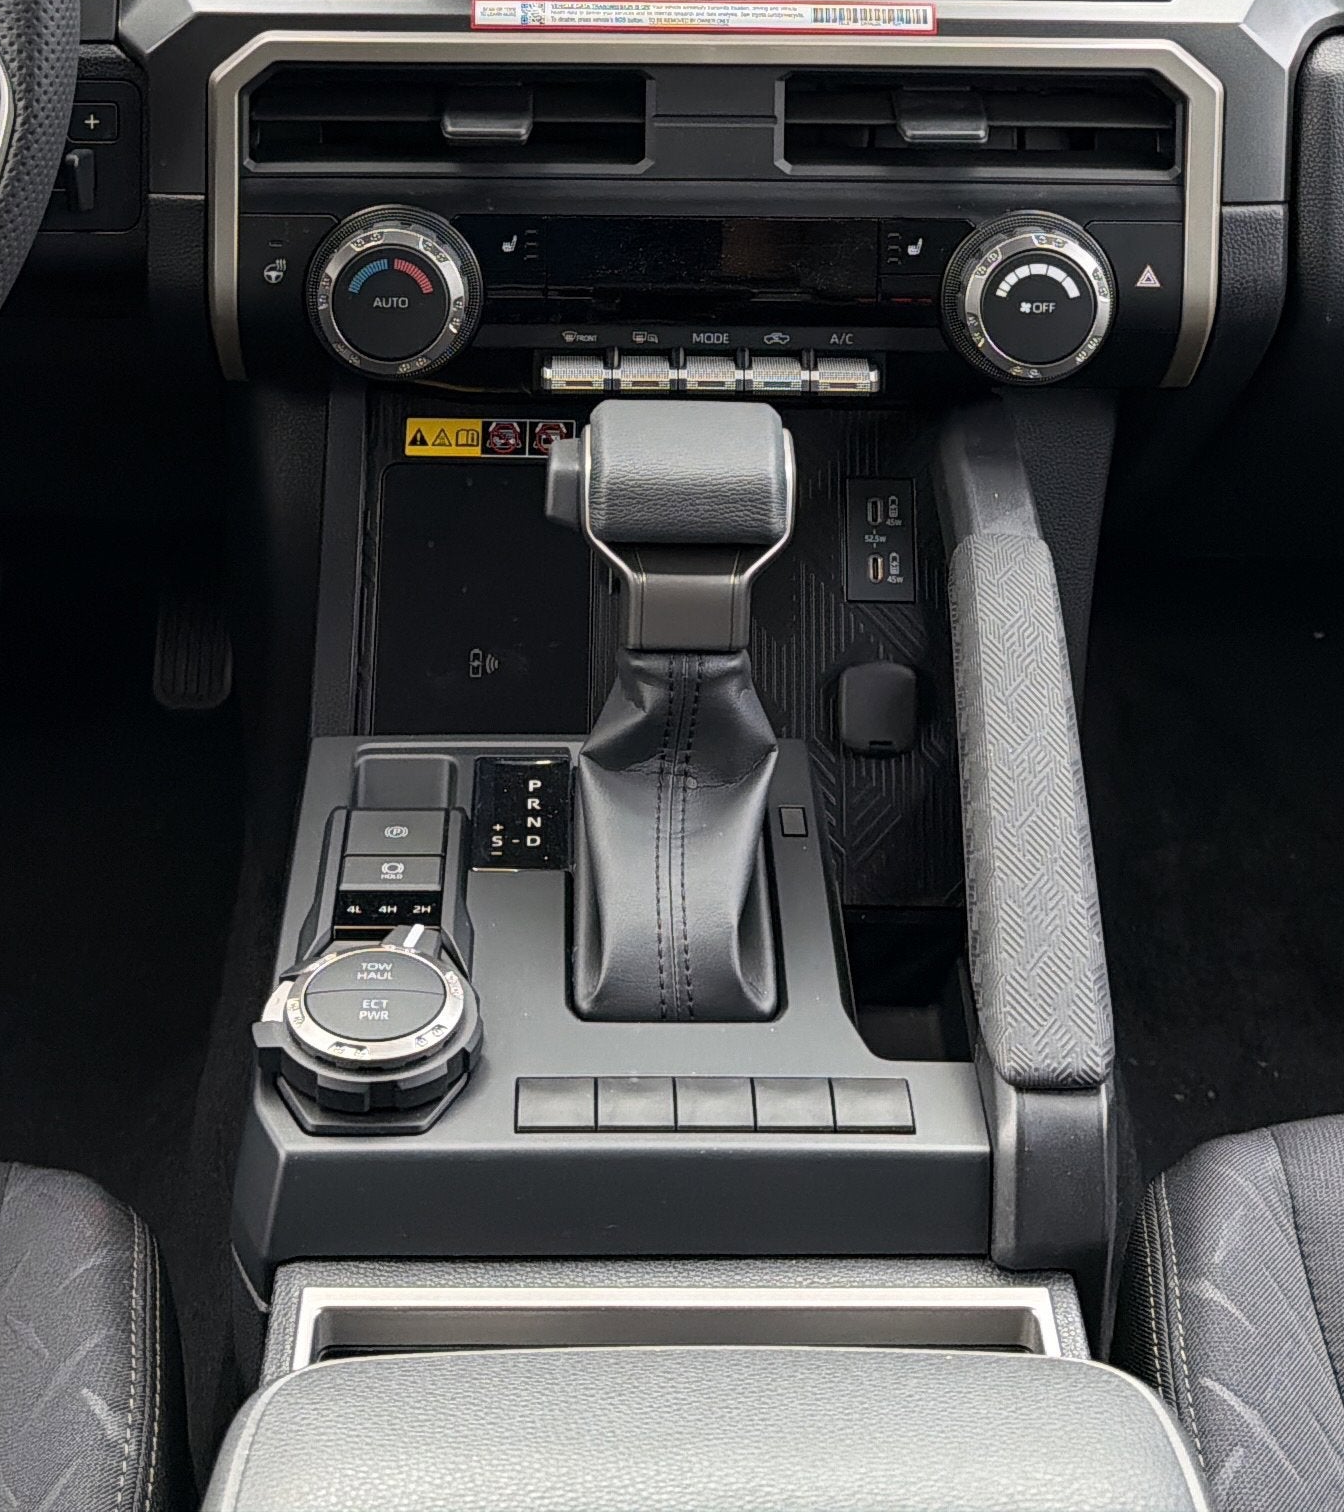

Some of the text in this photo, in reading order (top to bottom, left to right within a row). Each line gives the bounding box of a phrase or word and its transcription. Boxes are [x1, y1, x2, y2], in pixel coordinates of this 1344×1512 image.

[372, 296, 409, 309] AUTO
[1032, 302, 1056, 314] OFF
[576, 334, 597, 342] FRONT
[692, 332, 730, 344] MODE
[829, 333, 854, 345] A/C
[864, 534, 887, 543] 52.5W
[527, 779, 542, 792] P
[527, 798, 541, 810] R
[527, 816, 542, 828] N
[491, 835, 541, 847] S D
[346, 904, 432, 914] 4L 4H 2H
[360, 961, 393, 971] TOW
[356, 970, 394, 980] HAUL
[362, 999, 389, 1009] ECT
[358, 1010, 390, 1021] PWR
